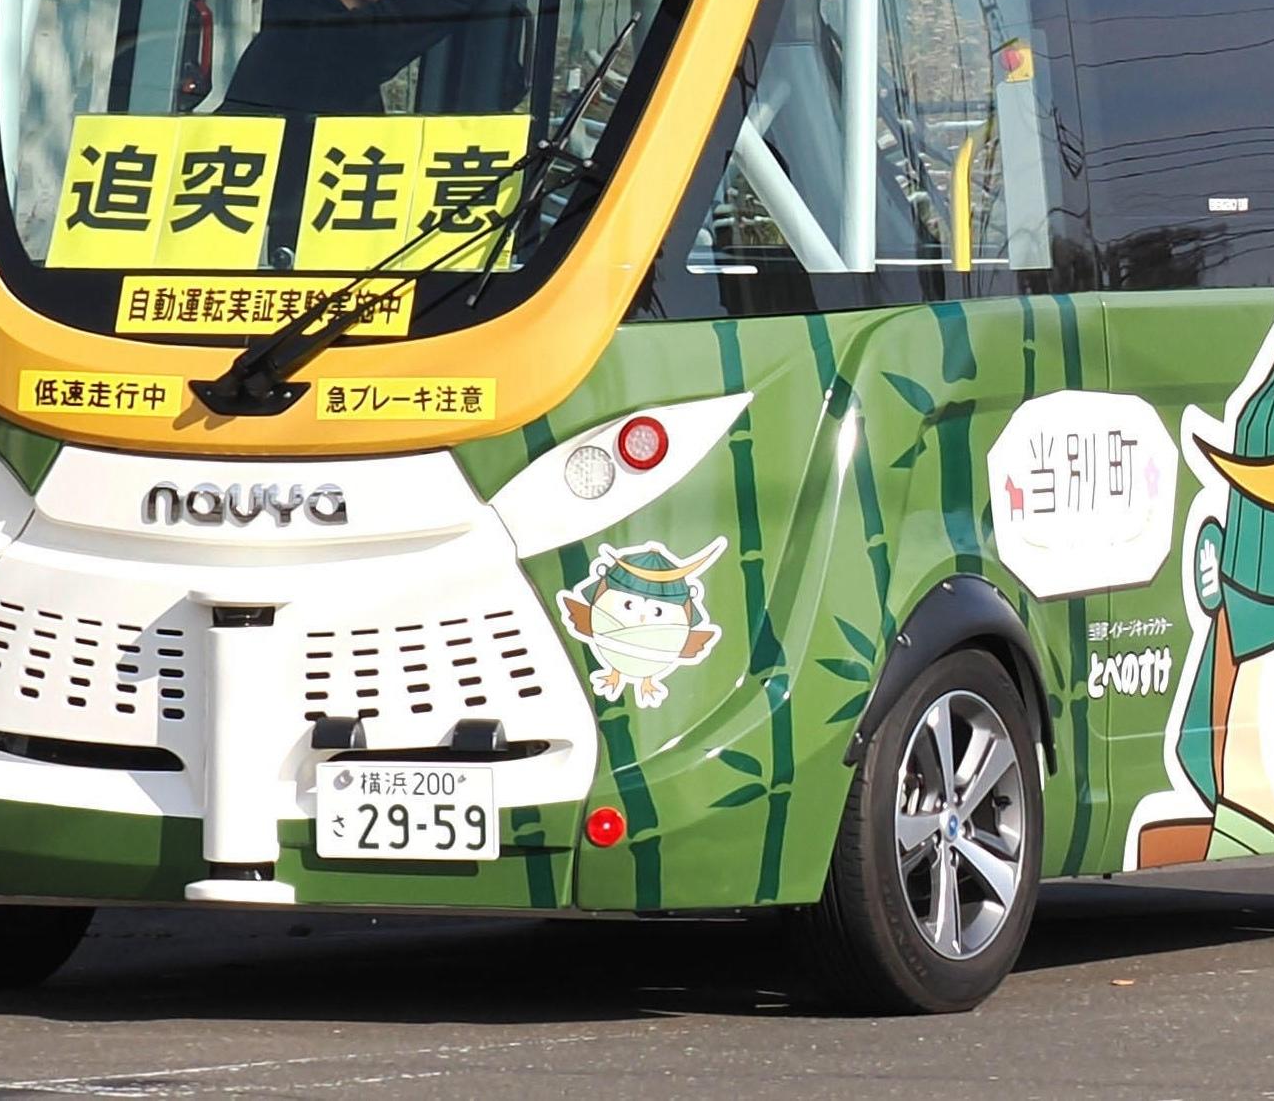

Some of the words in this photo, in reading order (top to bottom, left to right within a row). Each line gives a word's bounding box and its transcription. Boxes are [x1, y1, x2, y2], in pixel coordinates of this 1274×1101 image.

[35, 378, 166, 410] 低速走行中
[326, 385, 484, 413] 急ブレーキ注意
[1030, 431, 1138, 513] 当別町
[1087, 646, 1173, 699] とべのすけ
[357, 803, 487, 851] 29-59
